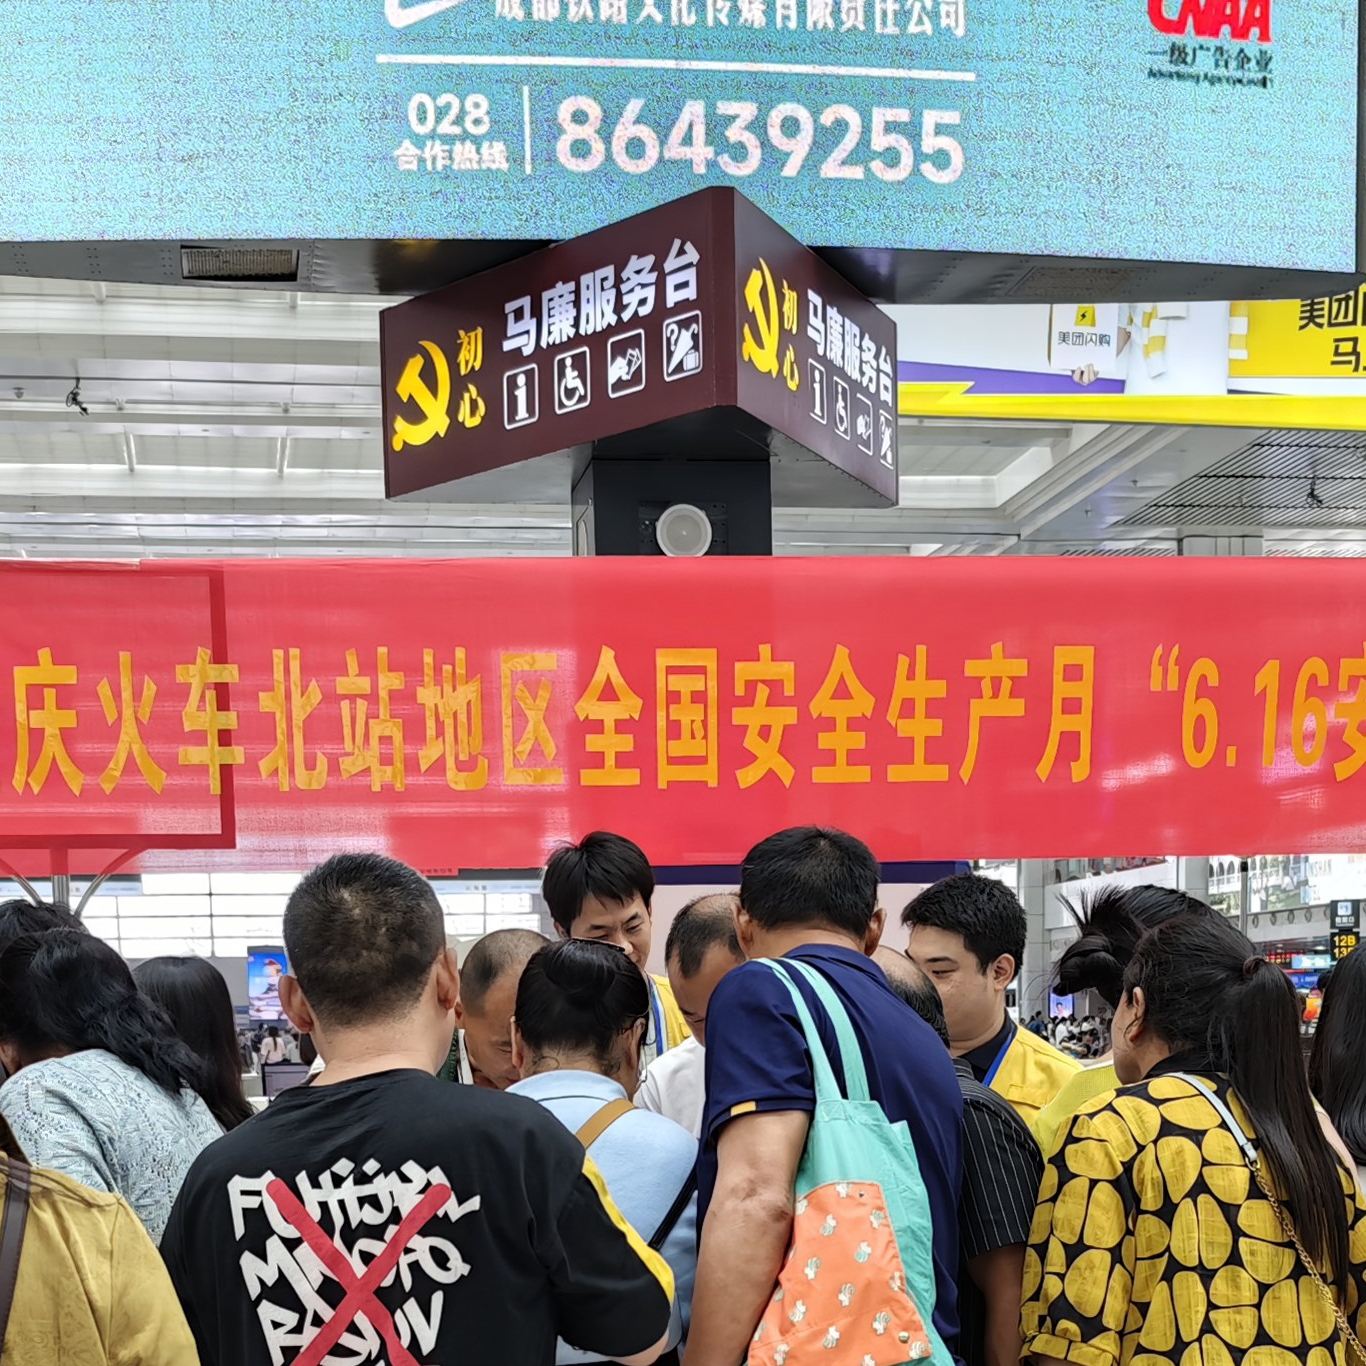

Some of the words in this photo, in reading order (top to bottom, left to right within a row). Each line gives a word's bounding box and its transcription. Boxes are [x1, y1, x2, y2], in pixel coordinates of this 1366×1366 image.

[394, 139, 510, 173] 合作热线
[407, 94, 491, 136] 028
[556, 95, 966, 184] 86439255
[501, 237, 700, 357] 马廉服务台
[781, 277, 800, 391] 初心
[1057, 330, 1111, 347] 美团闪购
[457, 326, 485, 429] 初心
[807, 289, 893, 407] 马廉服务台
[1334, 935, 1356, 946] 12B
